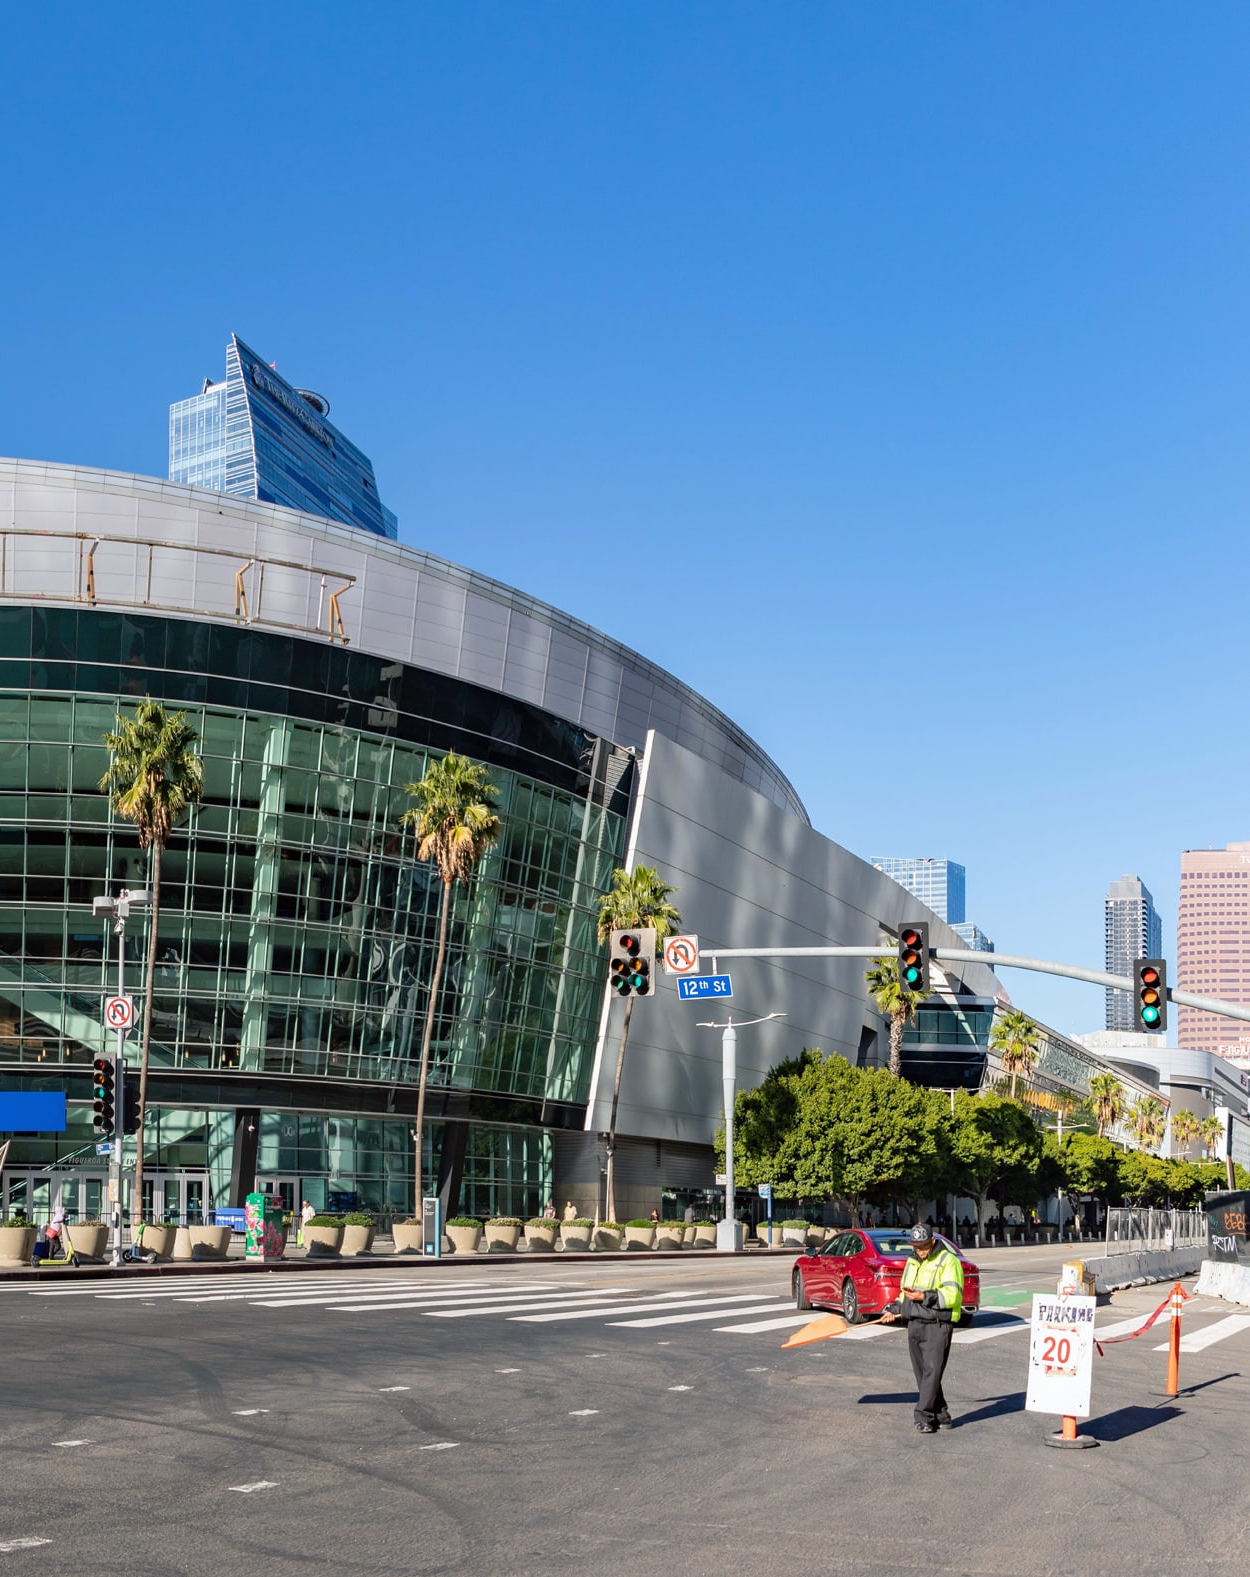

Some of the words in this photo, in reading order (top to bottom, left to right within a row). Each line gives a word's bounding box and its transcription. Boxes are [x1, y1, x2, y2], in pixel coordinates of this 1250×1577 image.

[683, 981, 709, 996] 12th
[713, 981, 727, 993] St
[1042, 1336, 1070, 1364] 20
